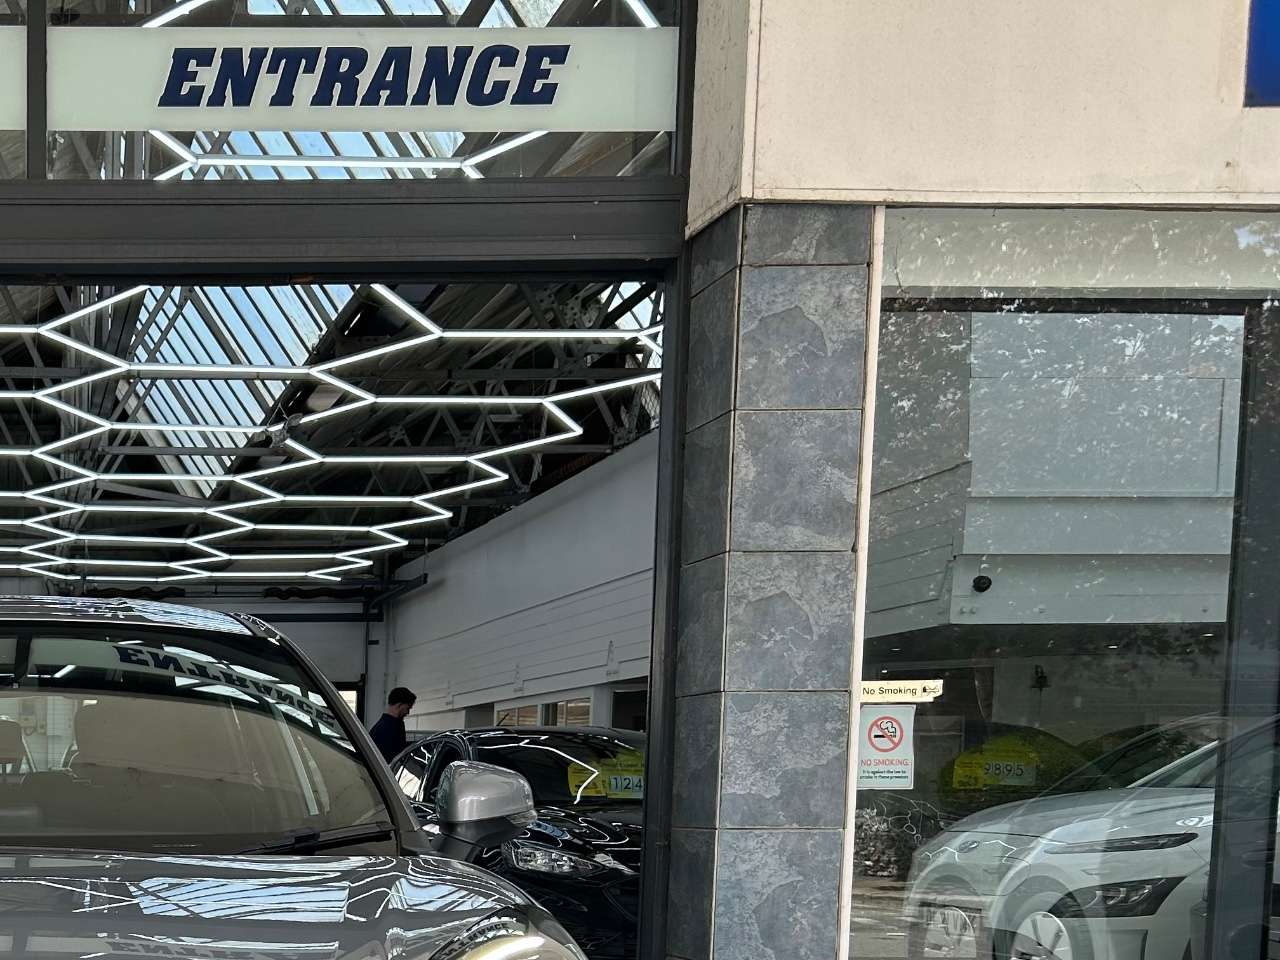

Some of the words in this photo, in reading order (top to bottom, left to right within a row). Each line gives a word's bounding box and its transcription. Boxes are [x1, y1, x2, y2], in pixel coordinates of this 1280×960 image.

[157, 44, 570, 107] ENTRANCE
[862, 687, 875, 695] No
[878, 686, 918, 696] Smoking
[873, 758, 910, 766] SMOKING
